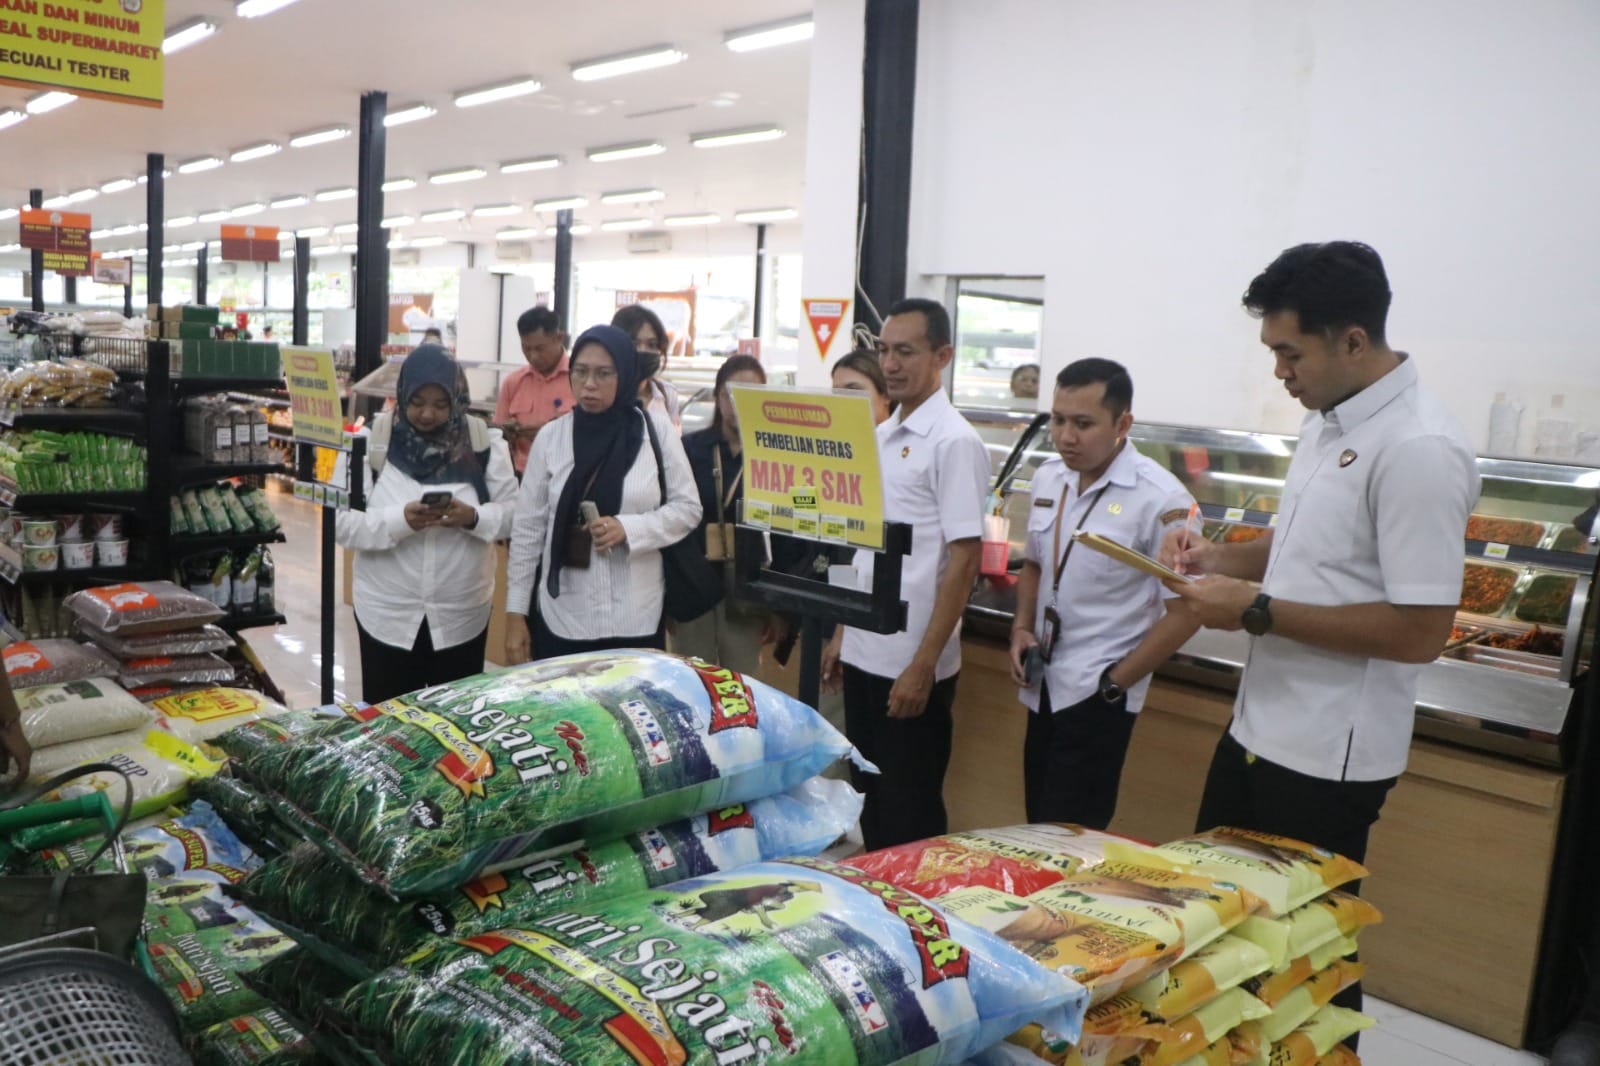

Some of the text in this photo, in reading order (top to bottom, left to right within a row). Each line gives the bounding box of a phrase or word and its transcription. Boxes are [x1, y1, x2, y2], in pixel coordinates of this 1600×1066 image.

[43, 3, 79, 23] DAN
[84, 11, 140, 34] MINUM
[36, 26, 160, 60] SUPERMARKET
[67, 59, 130, 82] TESTER
[755, 431, 853, 459] PEMBELIAN BERAS
[750, 459, 864, 507] MAX 3 SAK
[452, 694, 569, 786] Sejati
[185, 837, 204, 870] SUPER
[611, 937, 773, 1066] Sejati
